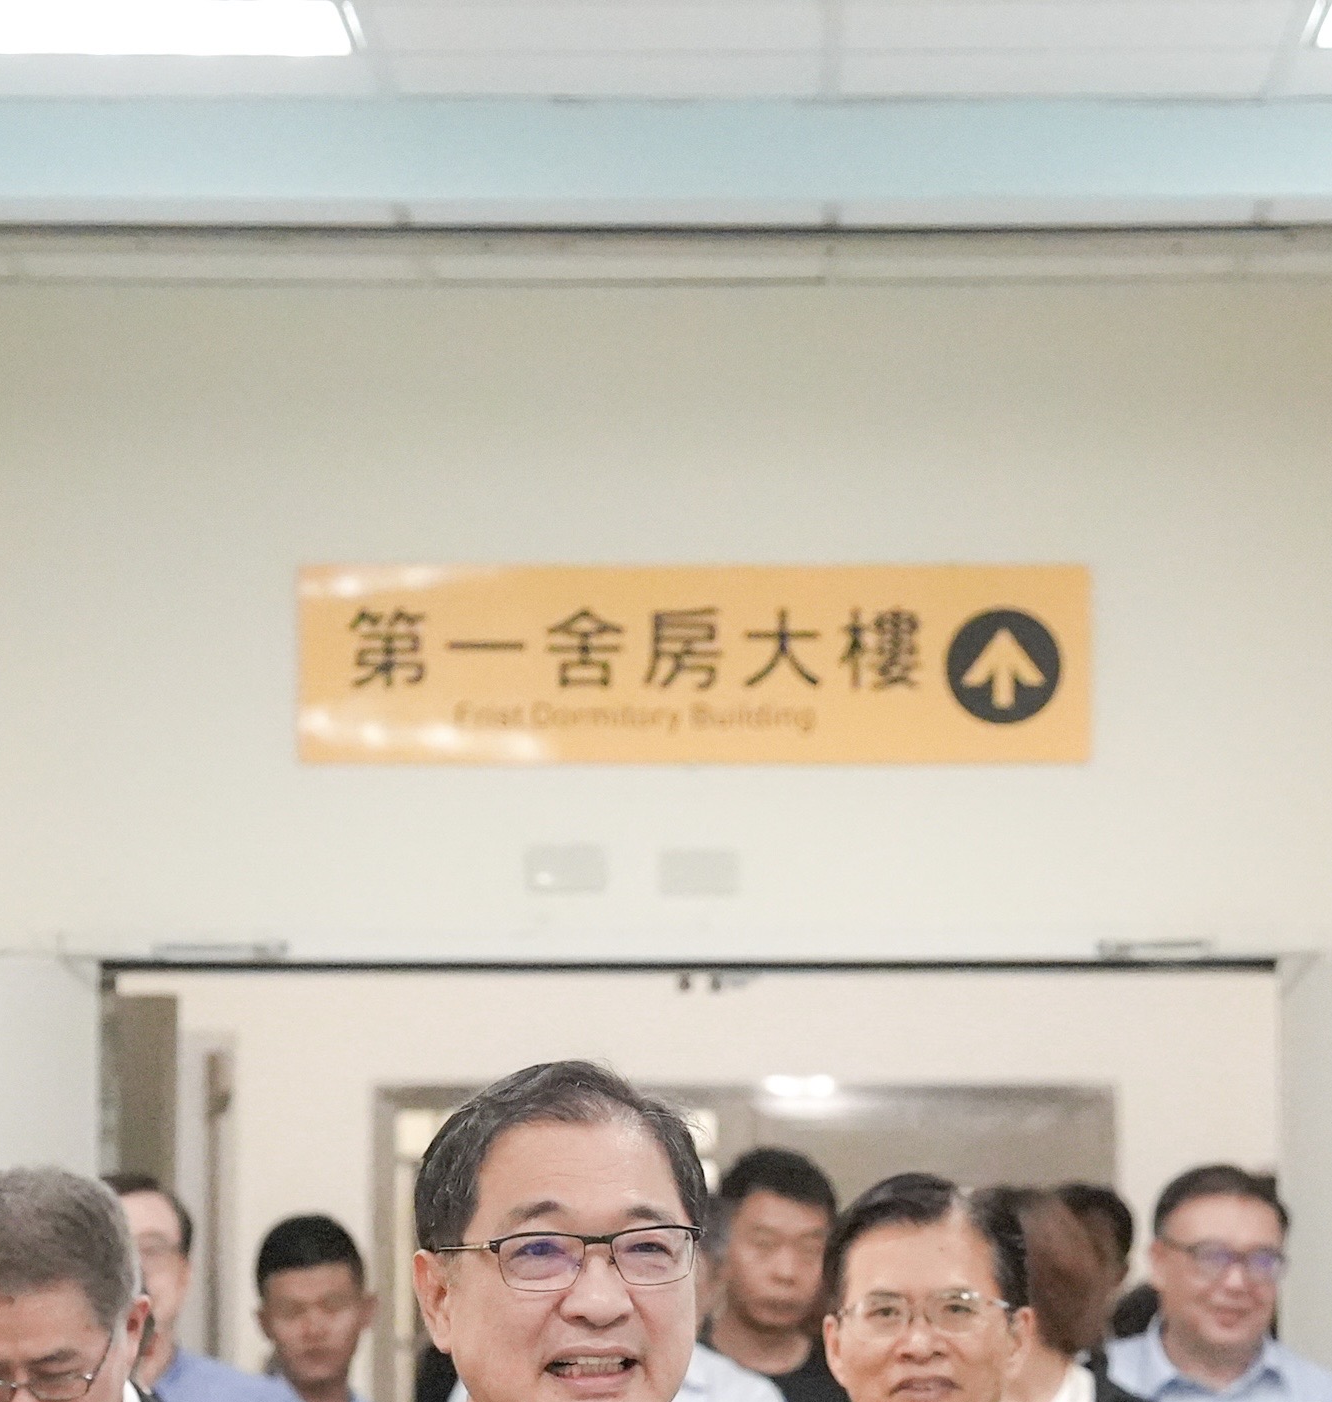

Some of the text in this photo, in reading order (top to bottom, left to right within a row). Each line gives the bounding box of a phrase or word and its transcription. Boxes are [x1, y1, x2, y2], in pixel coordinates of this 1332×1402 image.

[349, 605, 922, 688] 第一舍房大樓
[529, 701, 682, 734] Dormitory
[689, 701, 817, 734] Building
